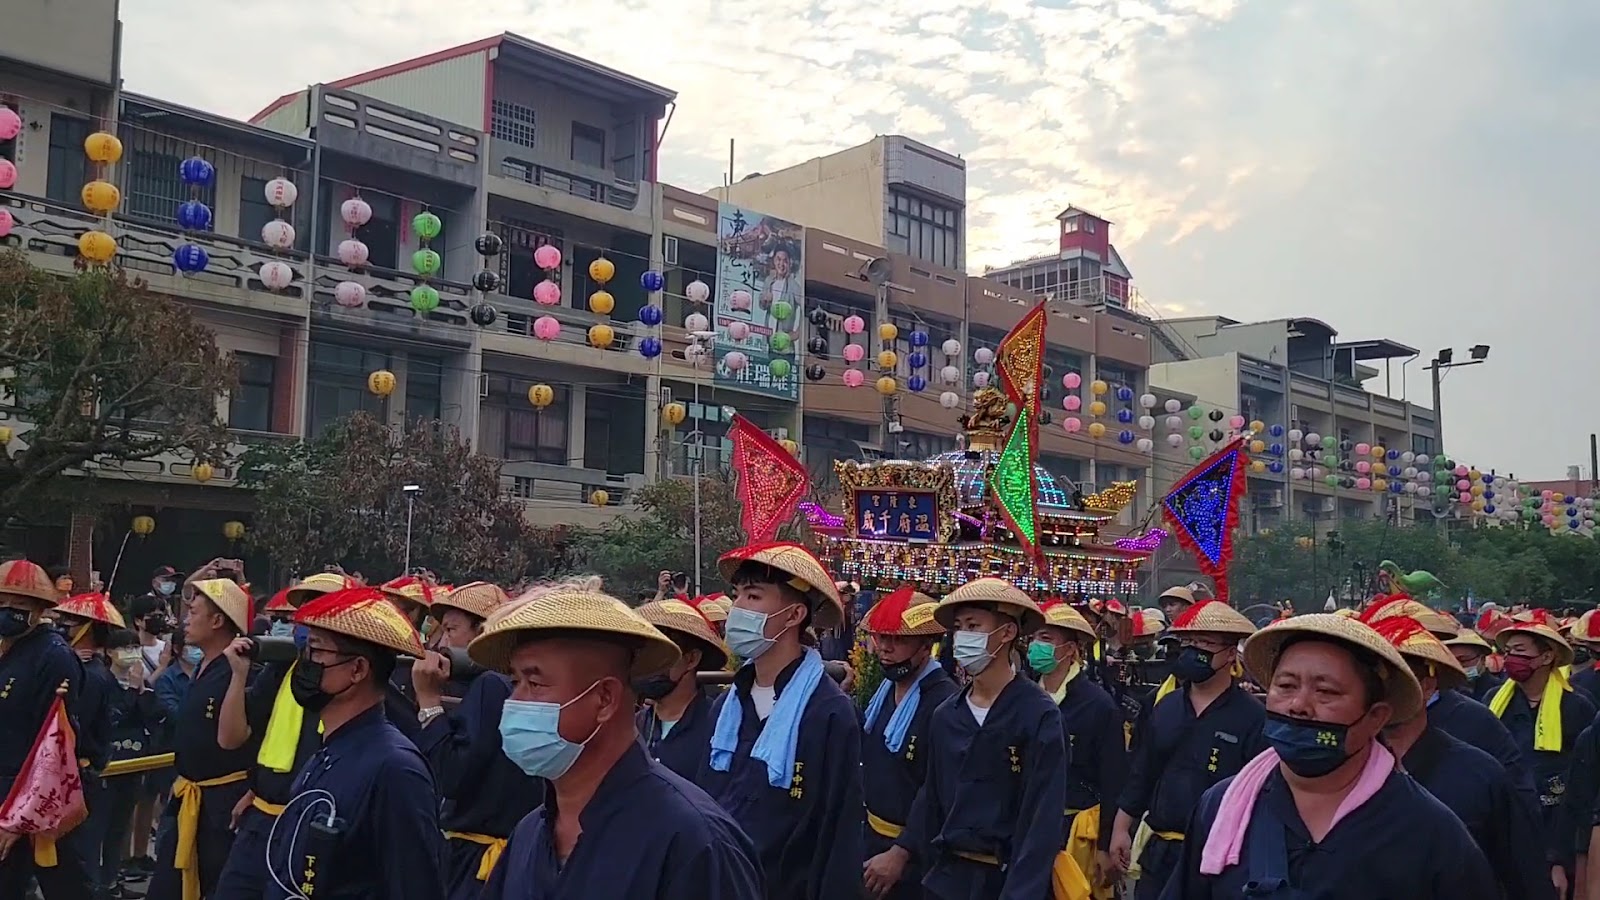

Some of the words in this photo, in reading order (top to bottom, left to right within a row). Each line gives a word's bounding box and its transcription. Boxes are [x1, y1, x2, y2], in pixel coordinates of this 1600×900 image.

[205, 697, 215, 719] 下中街
[906, 735, 917, 761] 下中街
[1008, 745, 1021, 774] 下中街
[1207, 747, 1220, 773] 下中街
[789, 761, 804, 799] 下中街
[301, 855, 316, 896] 下中街
